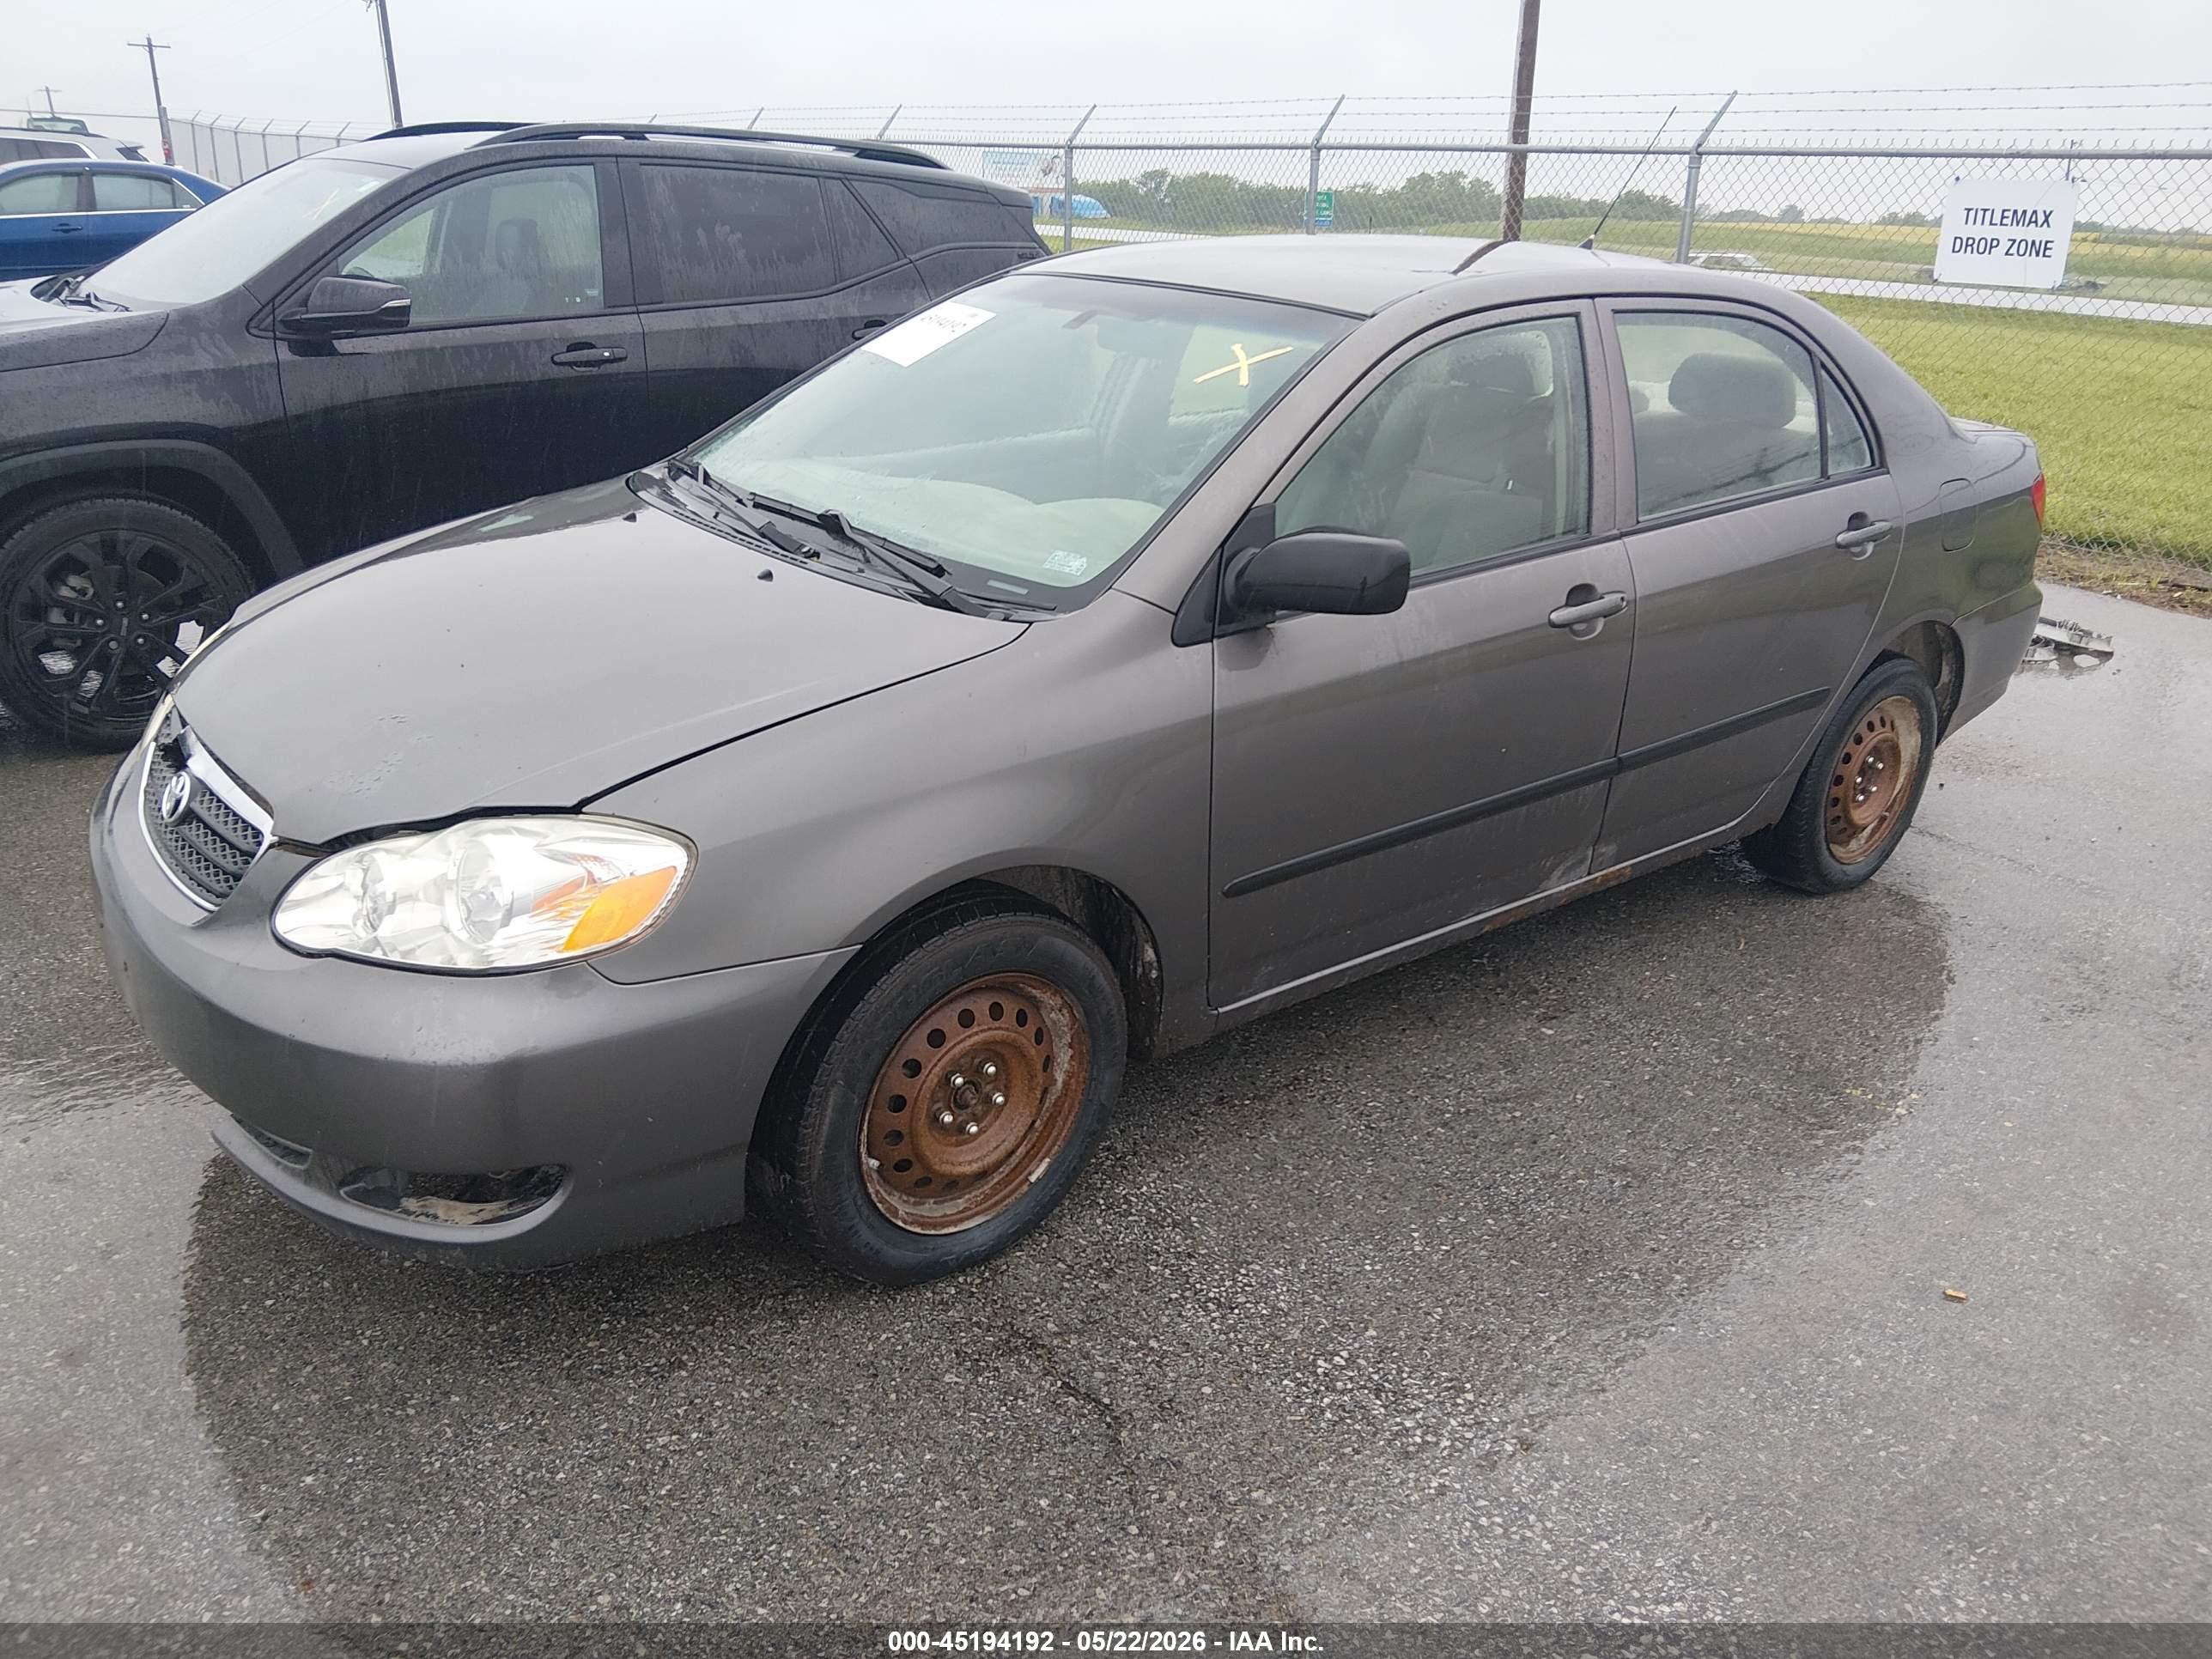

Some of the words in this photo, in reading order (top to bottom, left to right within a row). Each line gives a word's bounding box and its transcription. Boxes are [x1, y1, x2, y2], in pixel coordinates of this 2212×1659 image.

[1964, 207, 2054, 228] TITLEMAX
[1951, 236, 2000, 255] DROP
[2004, 239, 2055, 258] ZONE
